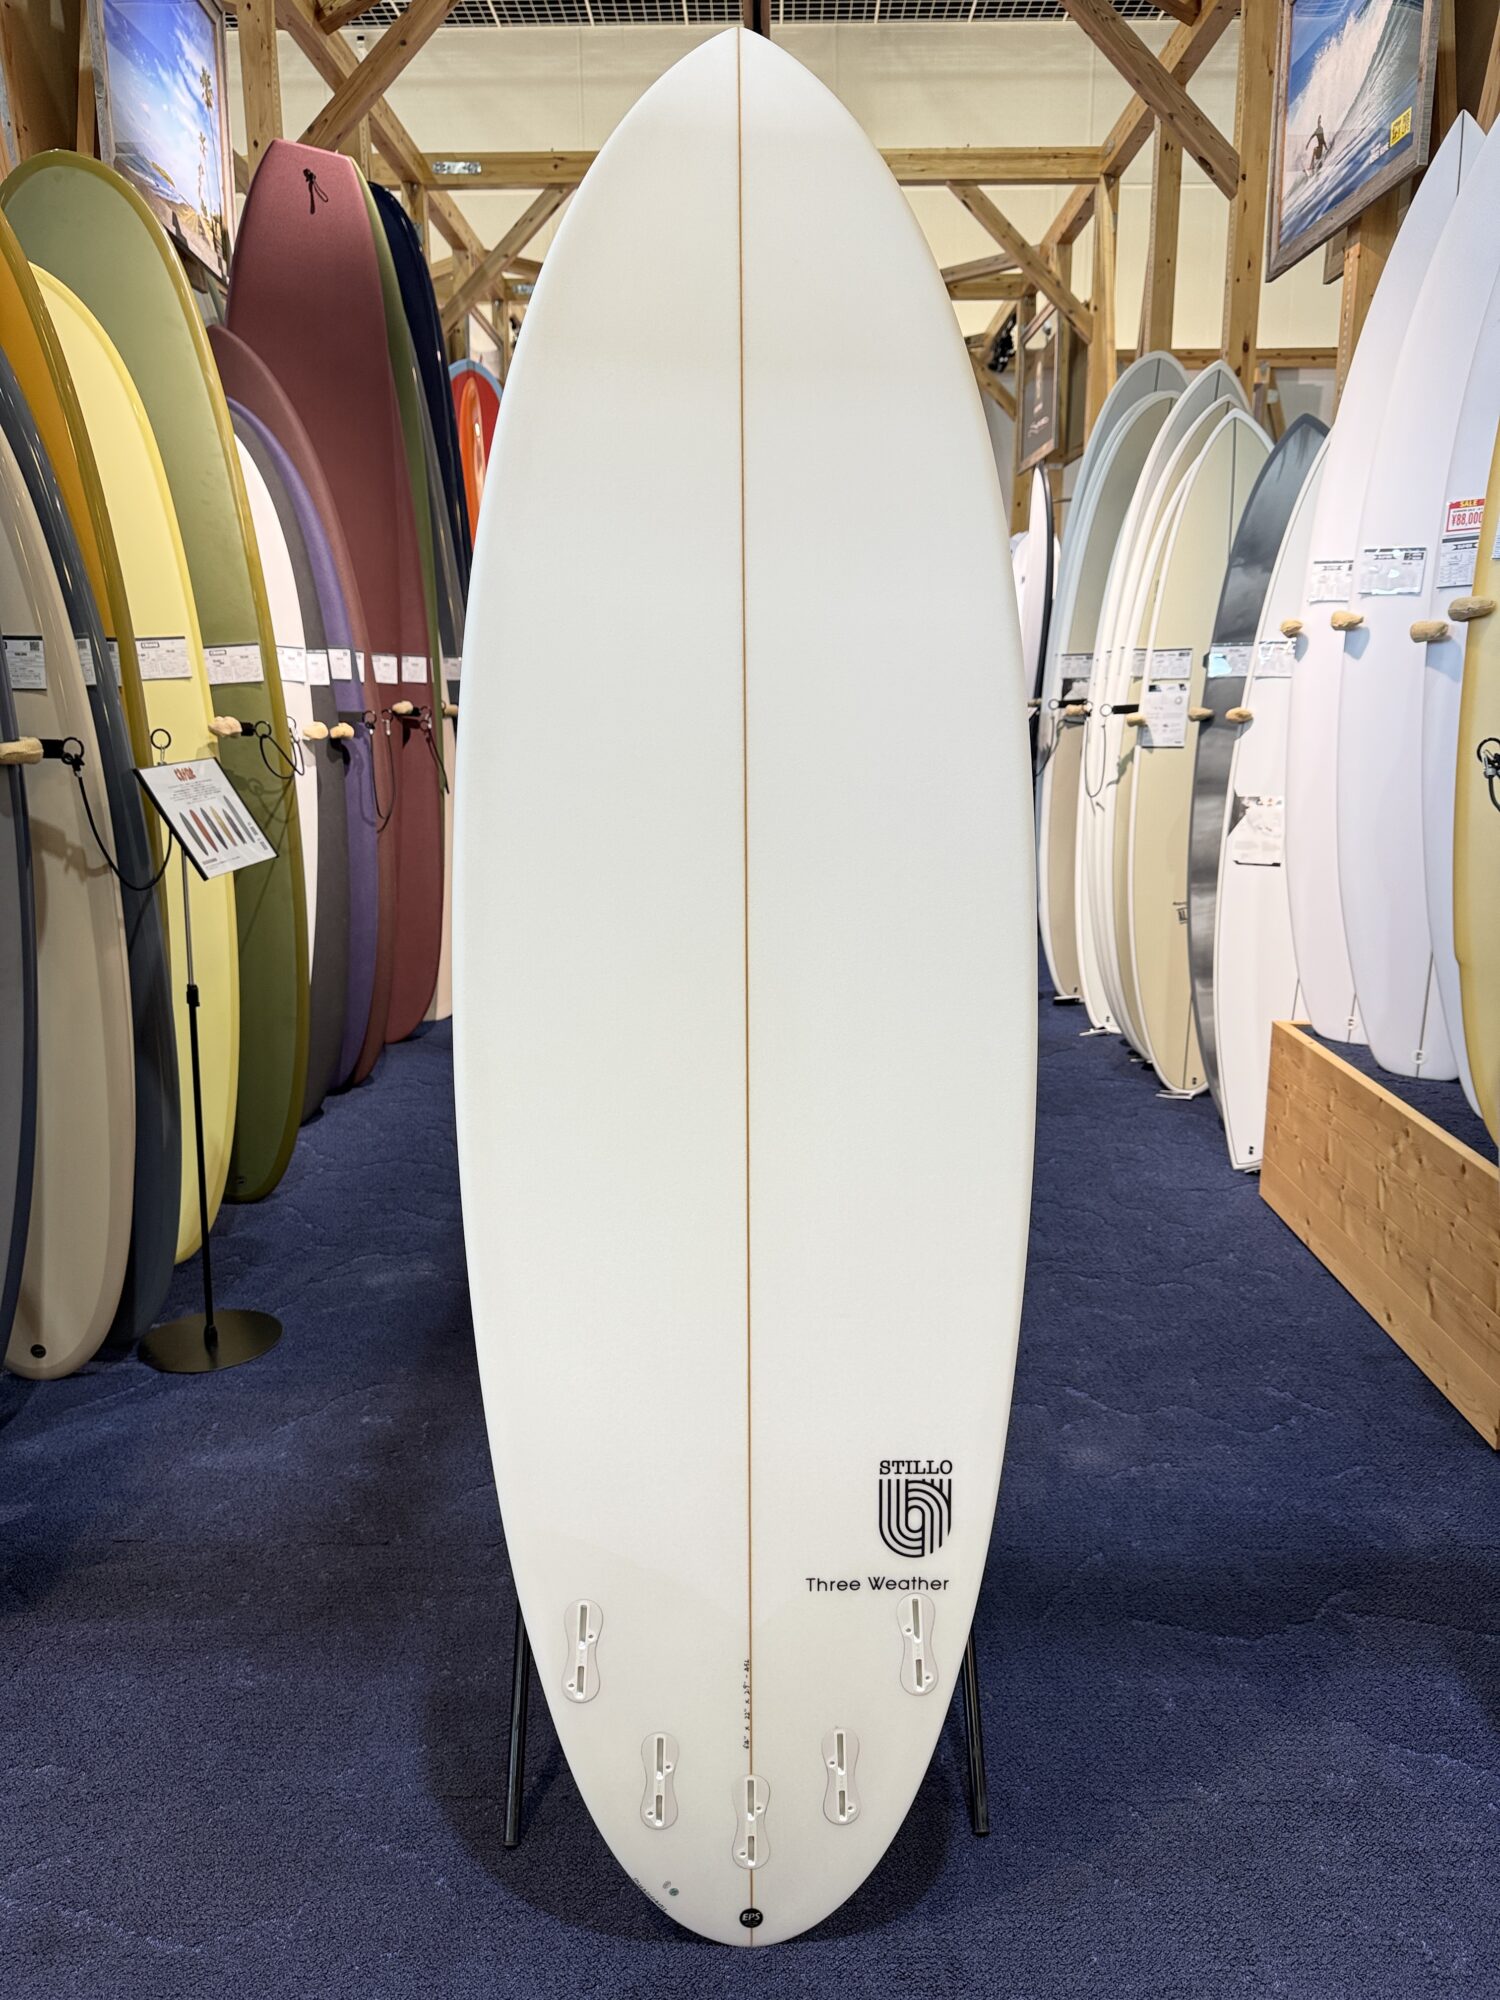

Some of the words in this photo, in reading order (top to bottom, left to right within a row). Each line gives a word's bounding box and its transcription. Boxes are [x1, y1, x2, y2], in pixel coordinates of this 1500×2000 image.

[879, 1459, 953, 1475] STILLO
[805, 1577, 861, 1592] Three
[868, 1576, 950, 1591] Weather
[742, 1912, 760, 1921] EPS
